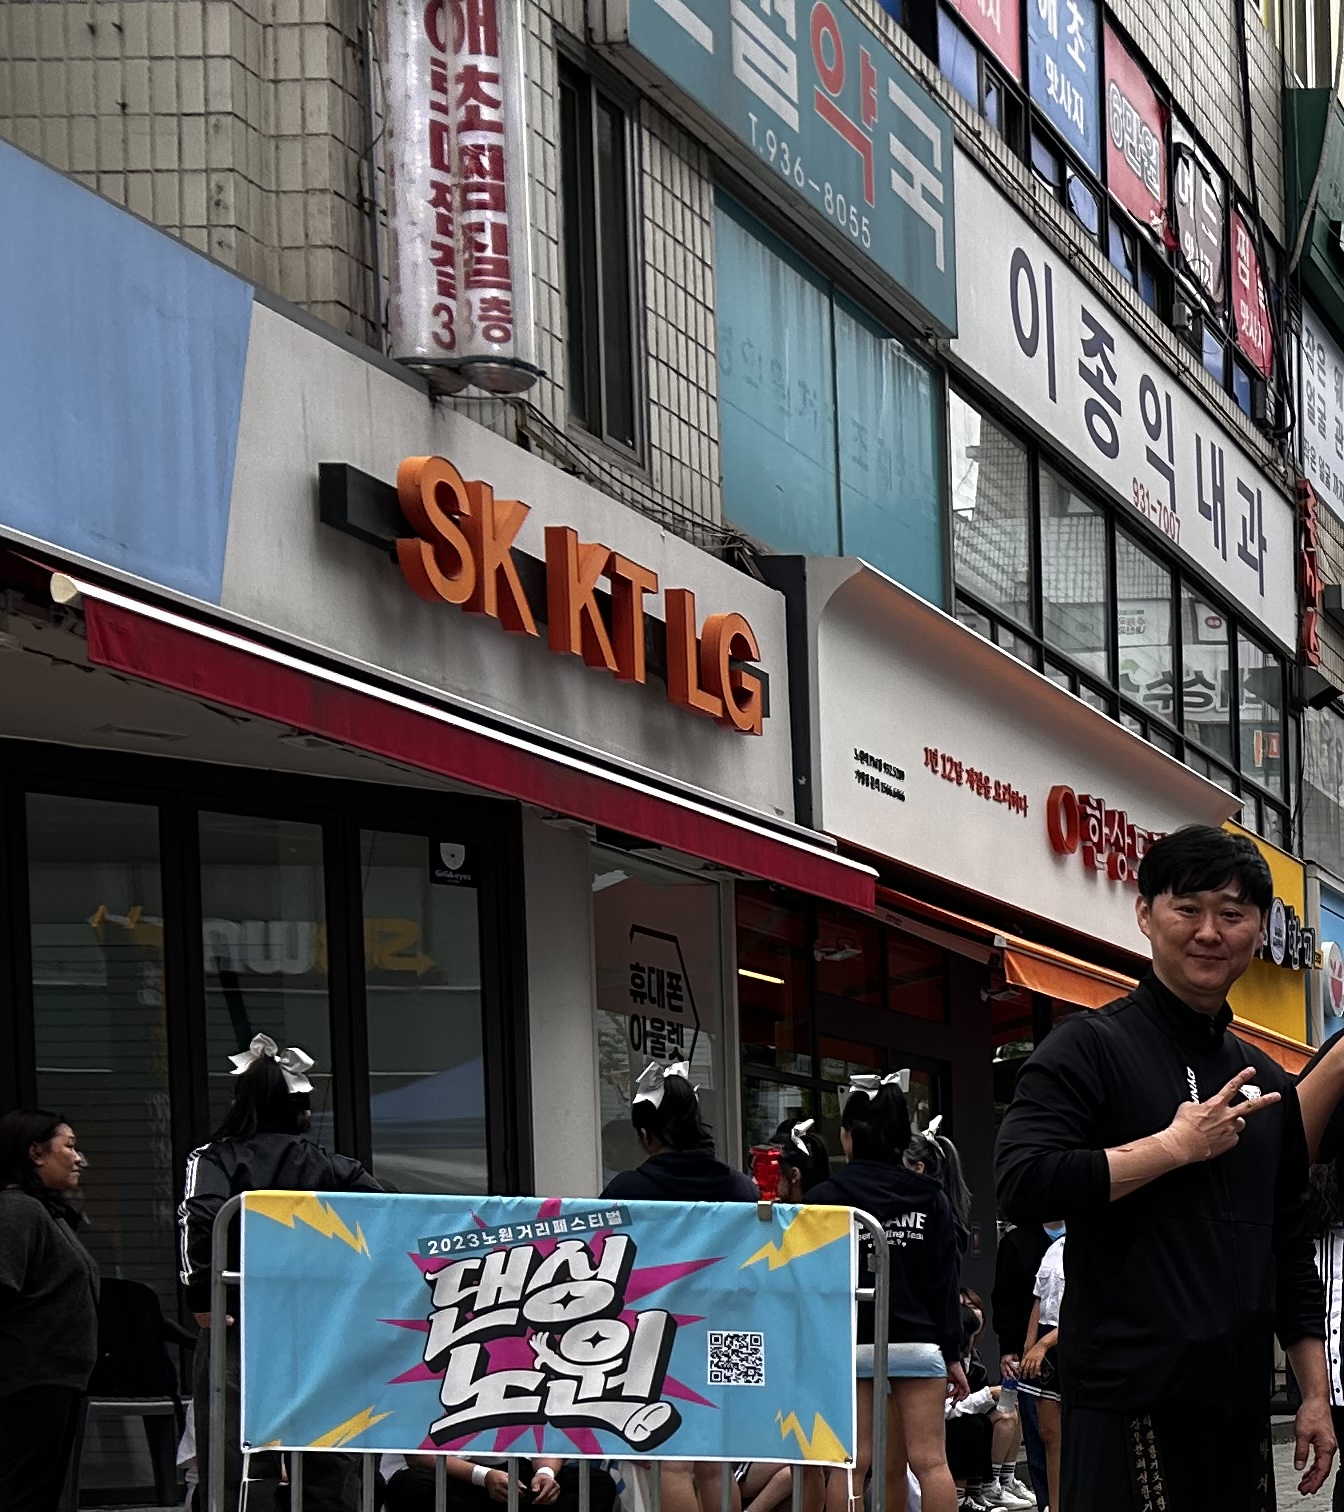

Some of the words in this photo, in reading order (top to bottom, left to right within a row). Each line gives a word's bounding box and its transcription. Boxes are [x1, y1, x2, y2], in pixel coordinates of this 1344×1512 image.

[748, 111, 871, 249] T.936-8055
[1009, 246, 1267, 598] 이종의내과
[396, 455, 540, 639] SK
[545, 525, 659, 685] KT
[665, 587, 764, 737] LG
[629, 961, 685, 1013] 휴대폰
[629, 1013, 685, 1062] 아울렛
[424, 1235, 630, 1364] 댄싱
